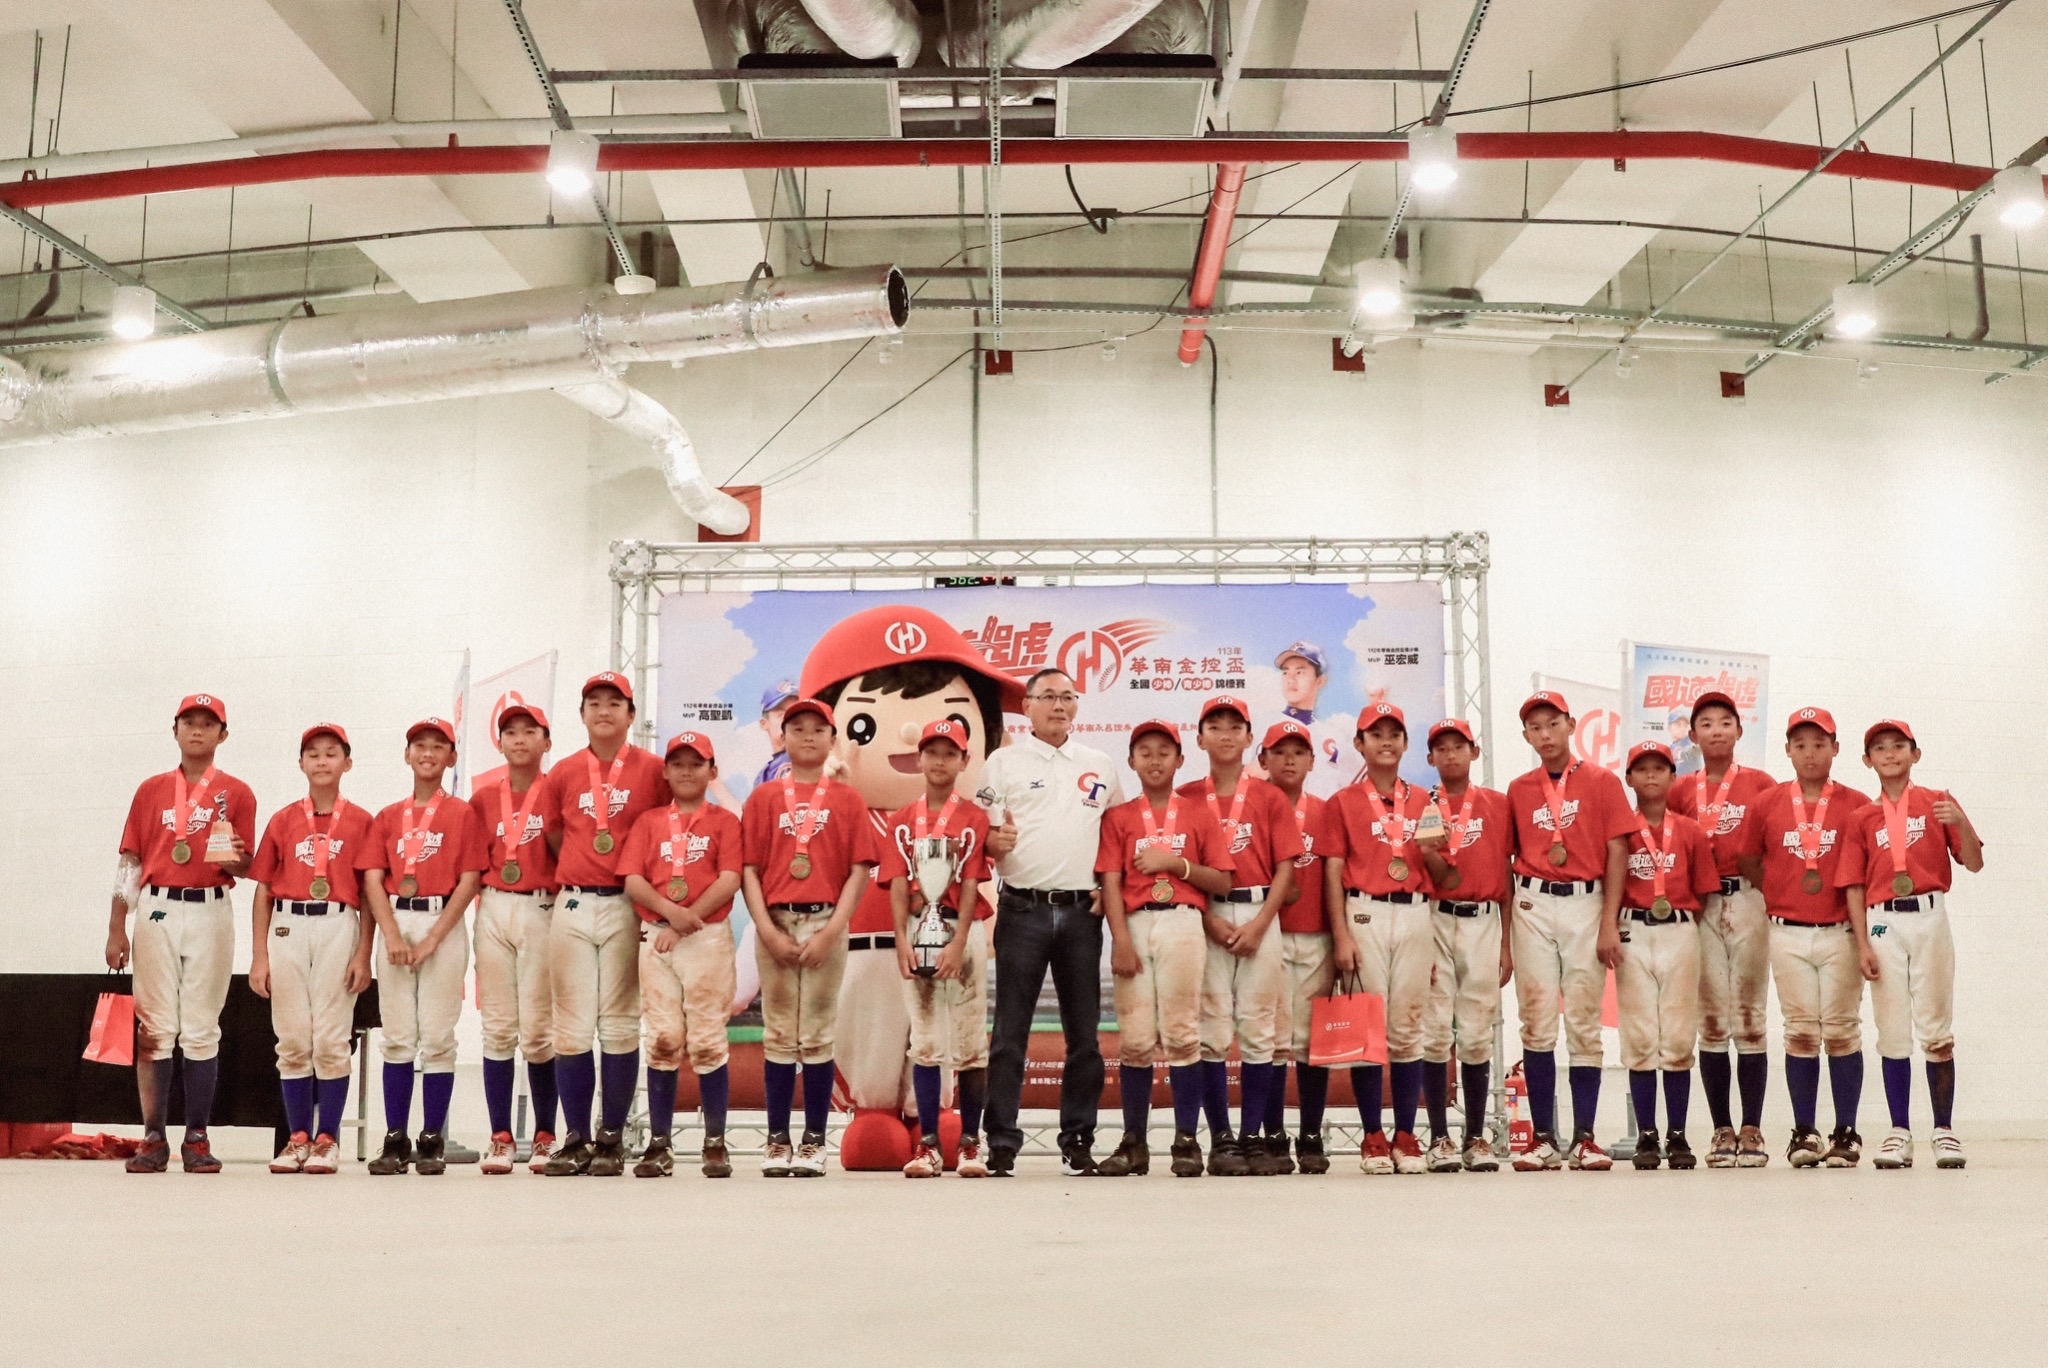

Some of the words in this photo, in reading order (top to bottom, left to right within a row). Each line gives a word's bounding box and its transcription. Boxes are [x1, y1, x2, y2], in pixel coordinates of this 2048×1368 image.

[1217, 647, 1242, 655] 113年
[1384, 653, 1419, 665] 巫宏威
[1129, 656, 1245, 676] 華南金控盃
